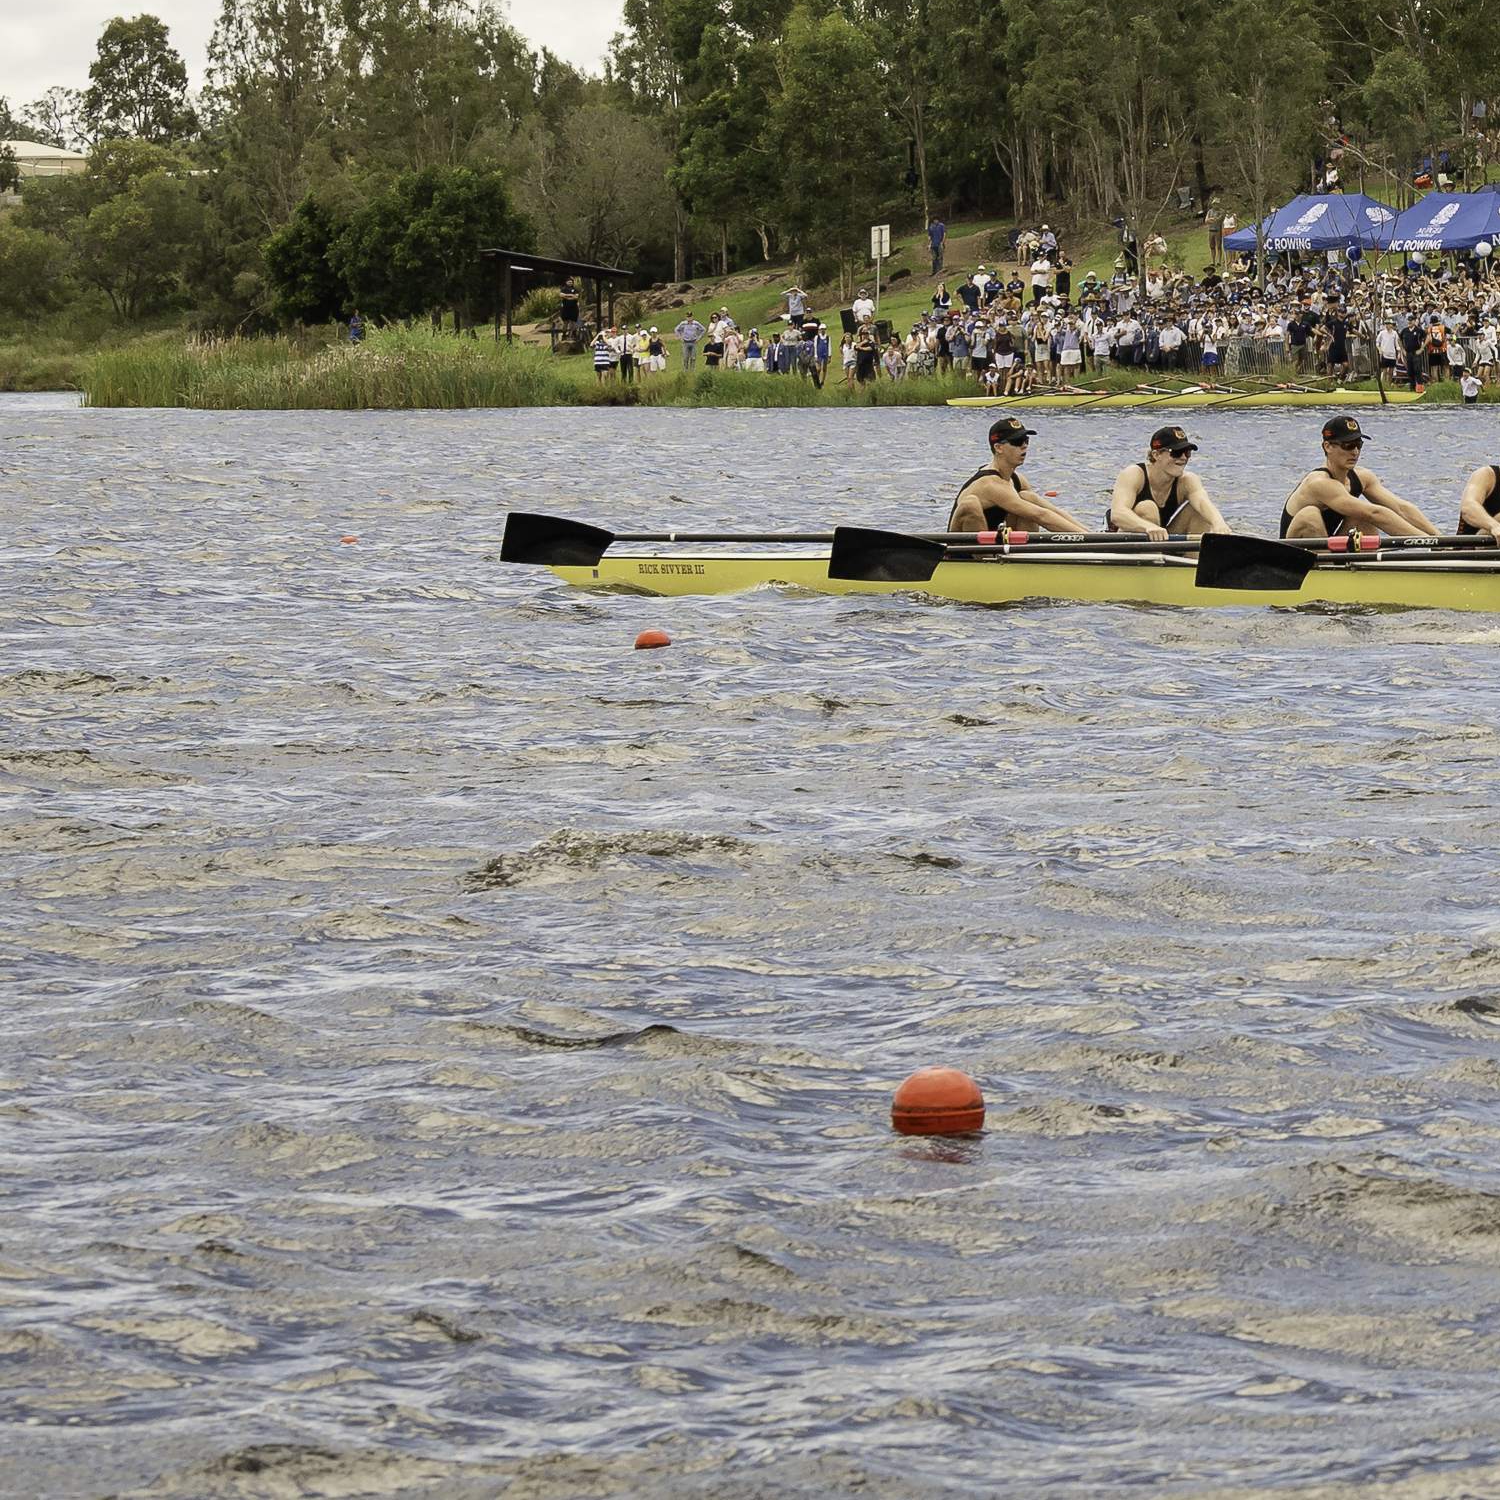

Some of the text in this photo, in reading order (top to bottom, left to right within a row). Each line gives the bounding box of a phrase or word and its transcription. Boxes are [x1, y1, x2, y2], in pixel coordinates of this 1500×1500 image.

[1275, 238, 1312, 250] ROWING
[1388, 239, 1442, 251] NC ROWING
[638, 564, 659, 575] RICK
[661, 564, 694, 575] SIVYER
